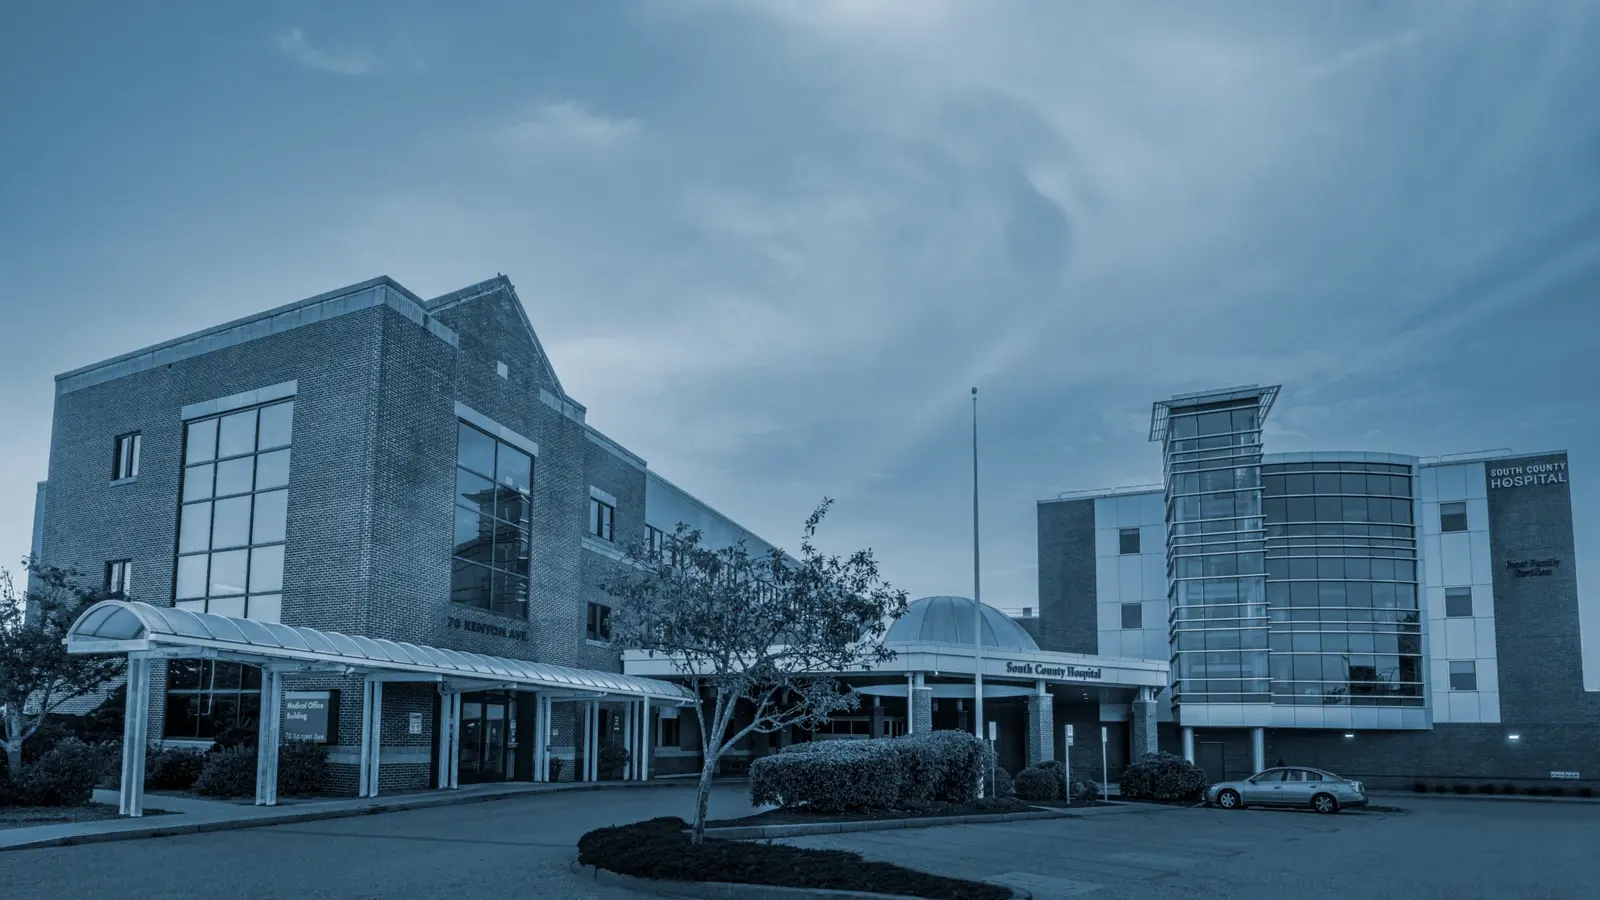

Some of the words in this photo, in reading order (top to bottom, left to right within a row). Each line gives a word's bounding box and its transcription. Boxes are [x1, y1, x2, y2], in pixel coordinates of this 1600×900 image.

[1490, 467, 1523, 477] SOUTH
[1526, 462, 1566, 474] COUNTY
[1491, 472, 1567, 489] HOSPITAL
[464, 620, 507, 638] KENYON
[1006, 661, 1033, 674] South
[1035, 664, 1066, 678] County
[1067, 666, 1102, 680] Hospital
[287, 701, 306, 709] Medical
[307, 700, 324, 709] Office
[287, 711, 307, 721] Building
